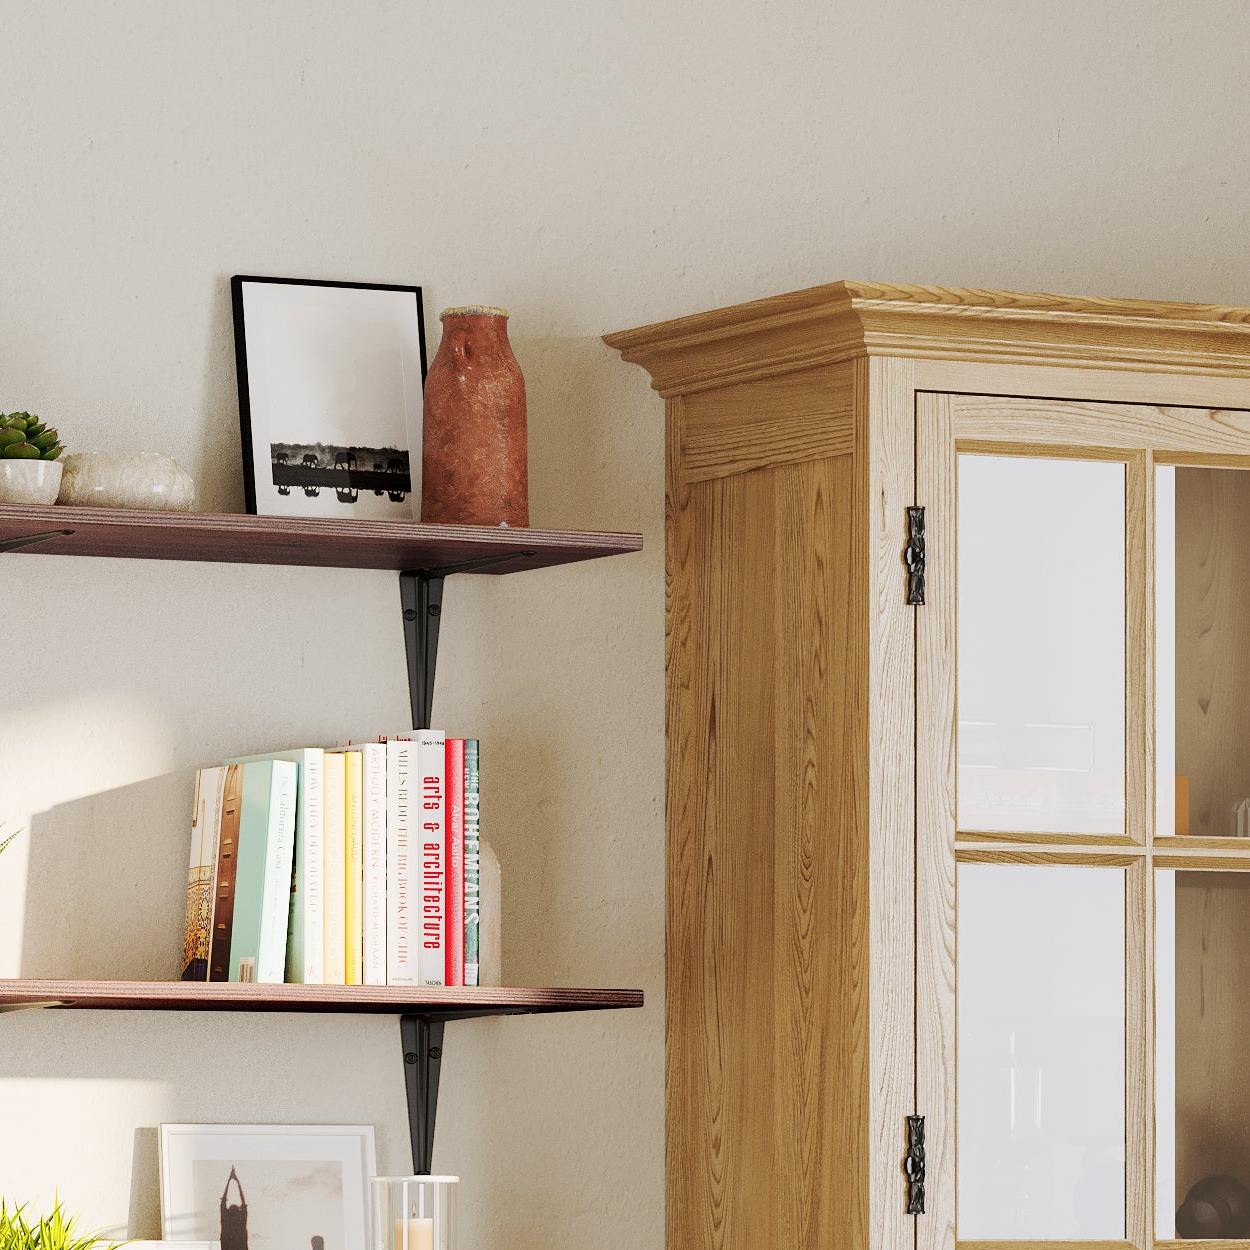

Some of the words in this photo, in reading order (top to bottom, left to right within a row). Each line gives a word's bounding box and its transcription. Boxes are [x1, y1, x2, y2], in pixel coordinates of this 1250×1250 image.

[369, 748, 381, 805] ARTFULLY
[423, 776, 443, 810] arts
[369, 809, 381, 868] MODERN
[451, 804, 461, 833] Alvar
[398, 878, 408, 913] BOOK
[423, 843, 444, 949] architecture
